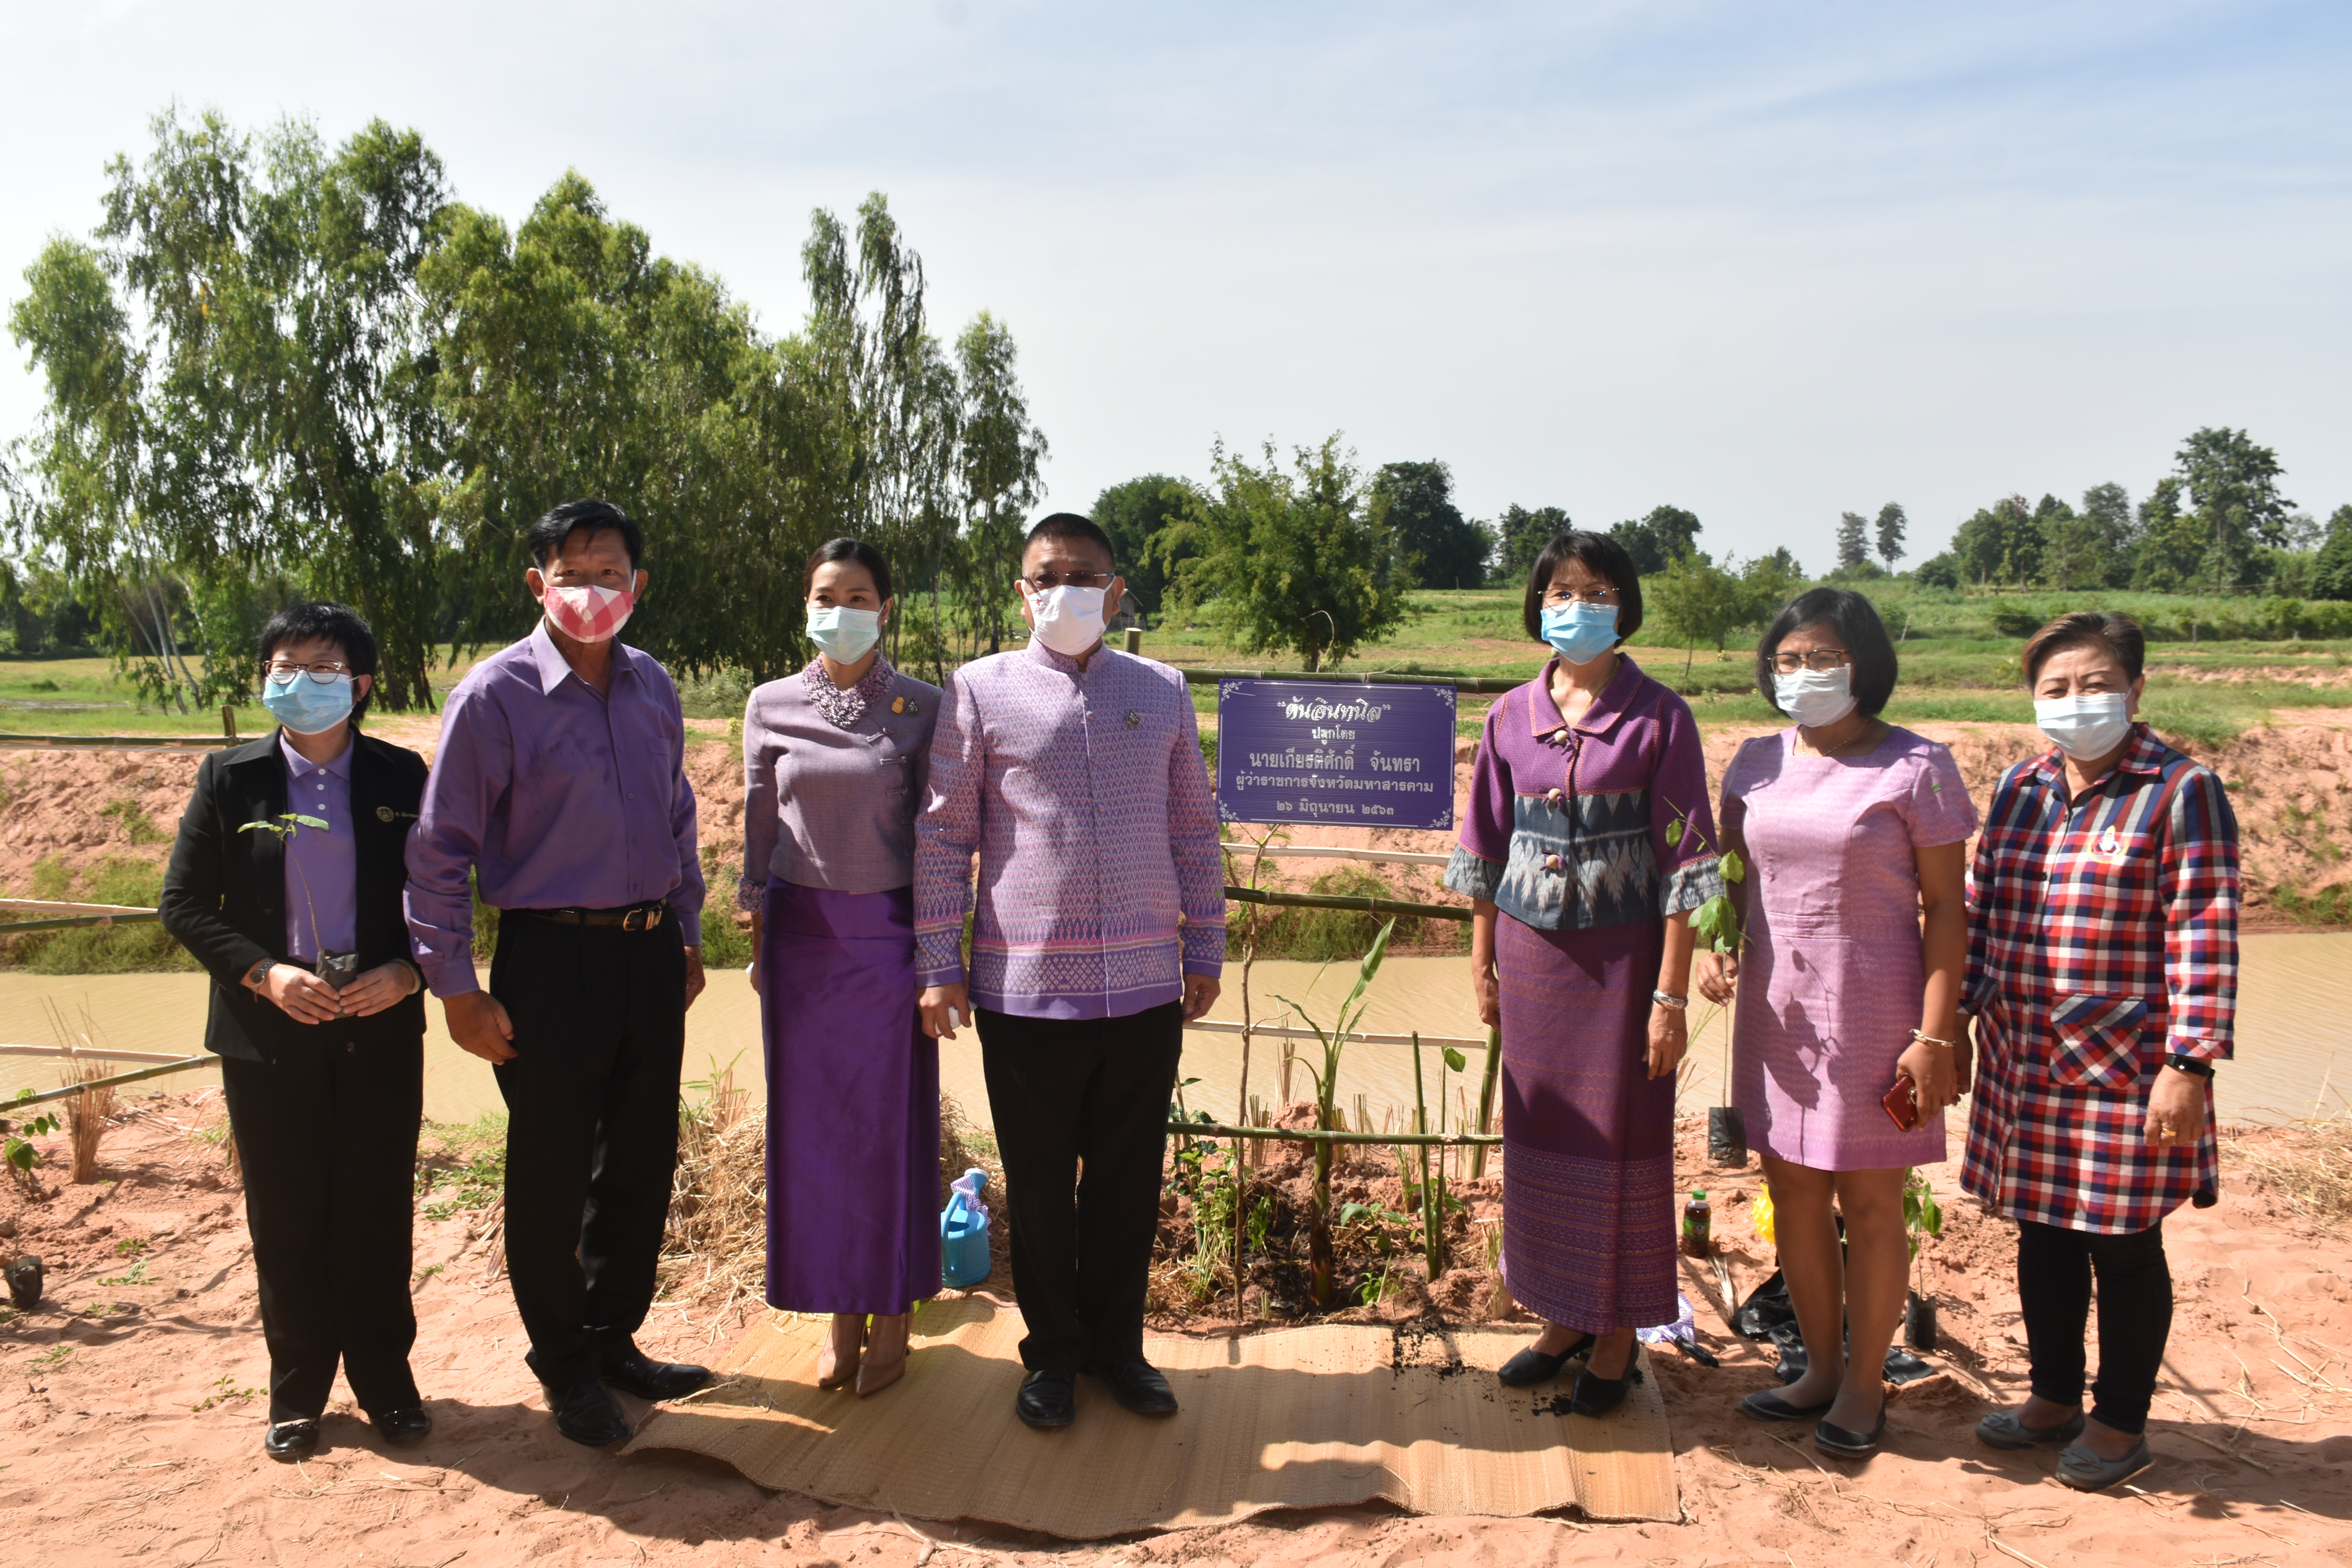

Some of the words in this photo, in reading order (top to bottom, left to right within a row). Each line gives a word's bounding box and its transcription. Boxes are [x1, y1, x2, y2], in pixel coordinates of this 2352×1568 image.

[1312, 724, 1355, 745] ปลูกโดย
[1250, 744, 1355, 770] นายเกียรติศักดิ์
[1370, 750, 1420, 772] จันทรา
[1236, 770, 1433, 792] ผู้ว่าราชการจังหวัดมหาสารคาม
[1277, 801, 1292, 811] ๒๖
[1299, 798, 1355, 817] มิถุนายน
[1362, 804, 1394, 815] ๒๕๖๓
